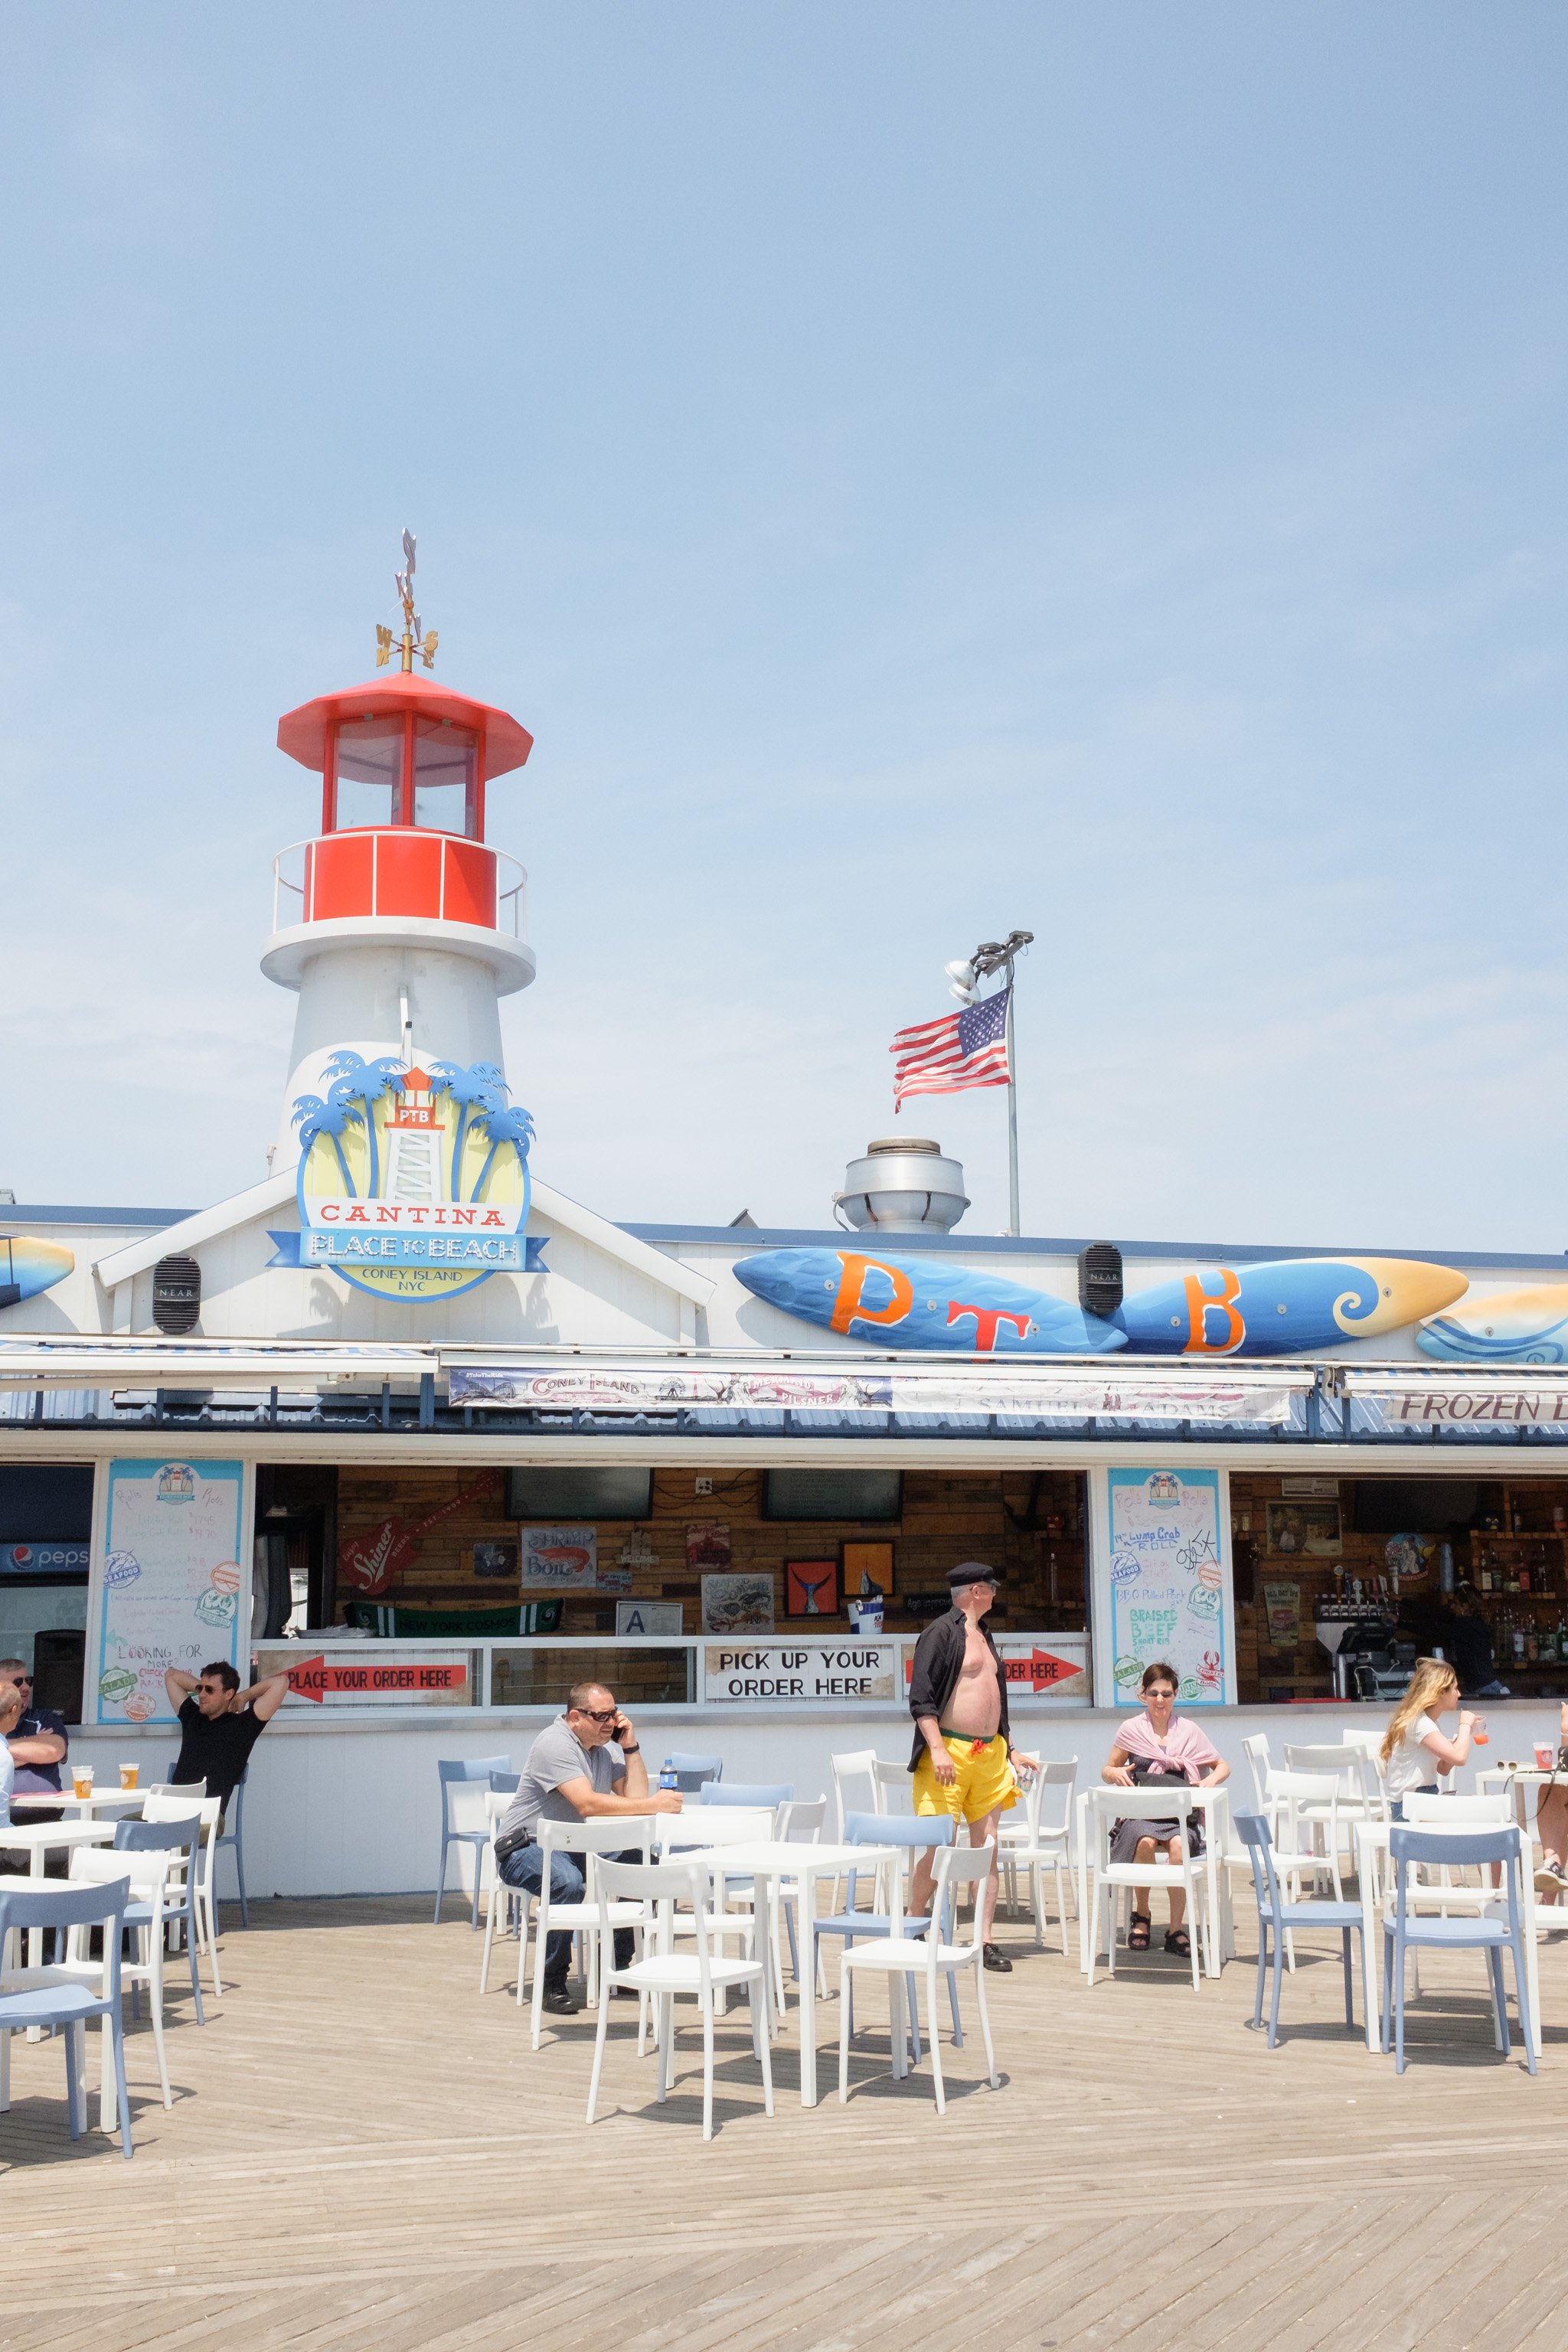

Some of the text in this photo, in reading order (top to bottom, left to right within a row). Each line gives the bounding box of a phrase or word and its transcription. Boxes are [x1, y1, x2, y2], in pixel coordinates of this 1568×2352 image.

[399, 1109, 430, 1122] PTB
[320, 1204, 506, 1227] CANTINA
[311, 1235, 518, 1262] PLACE TO BEACH
[362, 1268, 462, 1282] CONEY ISLAND
[398, 1282, 426, 1292] NYC
[531, 1373, 640, 1396] CONEY ISLAND
[781, 1392, 834, 1406] PILSNER
[1400, 1393, 1540, 1420] FROZEN
[1142, 1401, 1230, 1416] ADAMS
[1129, 1531, 1155, 1542] Lump
[1157, 1526, 1181, 1540] Crab
[391, 1534, 410, 1558] BEERS
[1138, 1541, 1177, 1551] ROLL
[38, 1550, 90, 1567] peps
[353, 1521, 393, 1591] Shiner
[620, 1555, 655, 1564] WELCOME
[1142, 1589, 1164, 1600] Pulled
[1166, 1588, 1187, 1599] Pork
[625, 1609, 646, 1634] A
[1129, 1609, 1178, 1622] BRAISED
[398, 1616, 516, 1632] NEW YORK COSMOS
[1131, 1622, 1177, 1638] BEEF
[1132, 1637, 1155, 1647] SHORT
[119, 1644, 202, 1660] LOOKING FOR
[720, 1651, 880, 1671] PICK UP YOUR
[1004, 1662, 1059, 1681] DER HERE
[98, 1674, 136, 1694] SALADS
[289, 1670, 452, 1690] PLACE YOUR ORDER HERE
[728, 1677, 873, 1696] ORDER HERE
